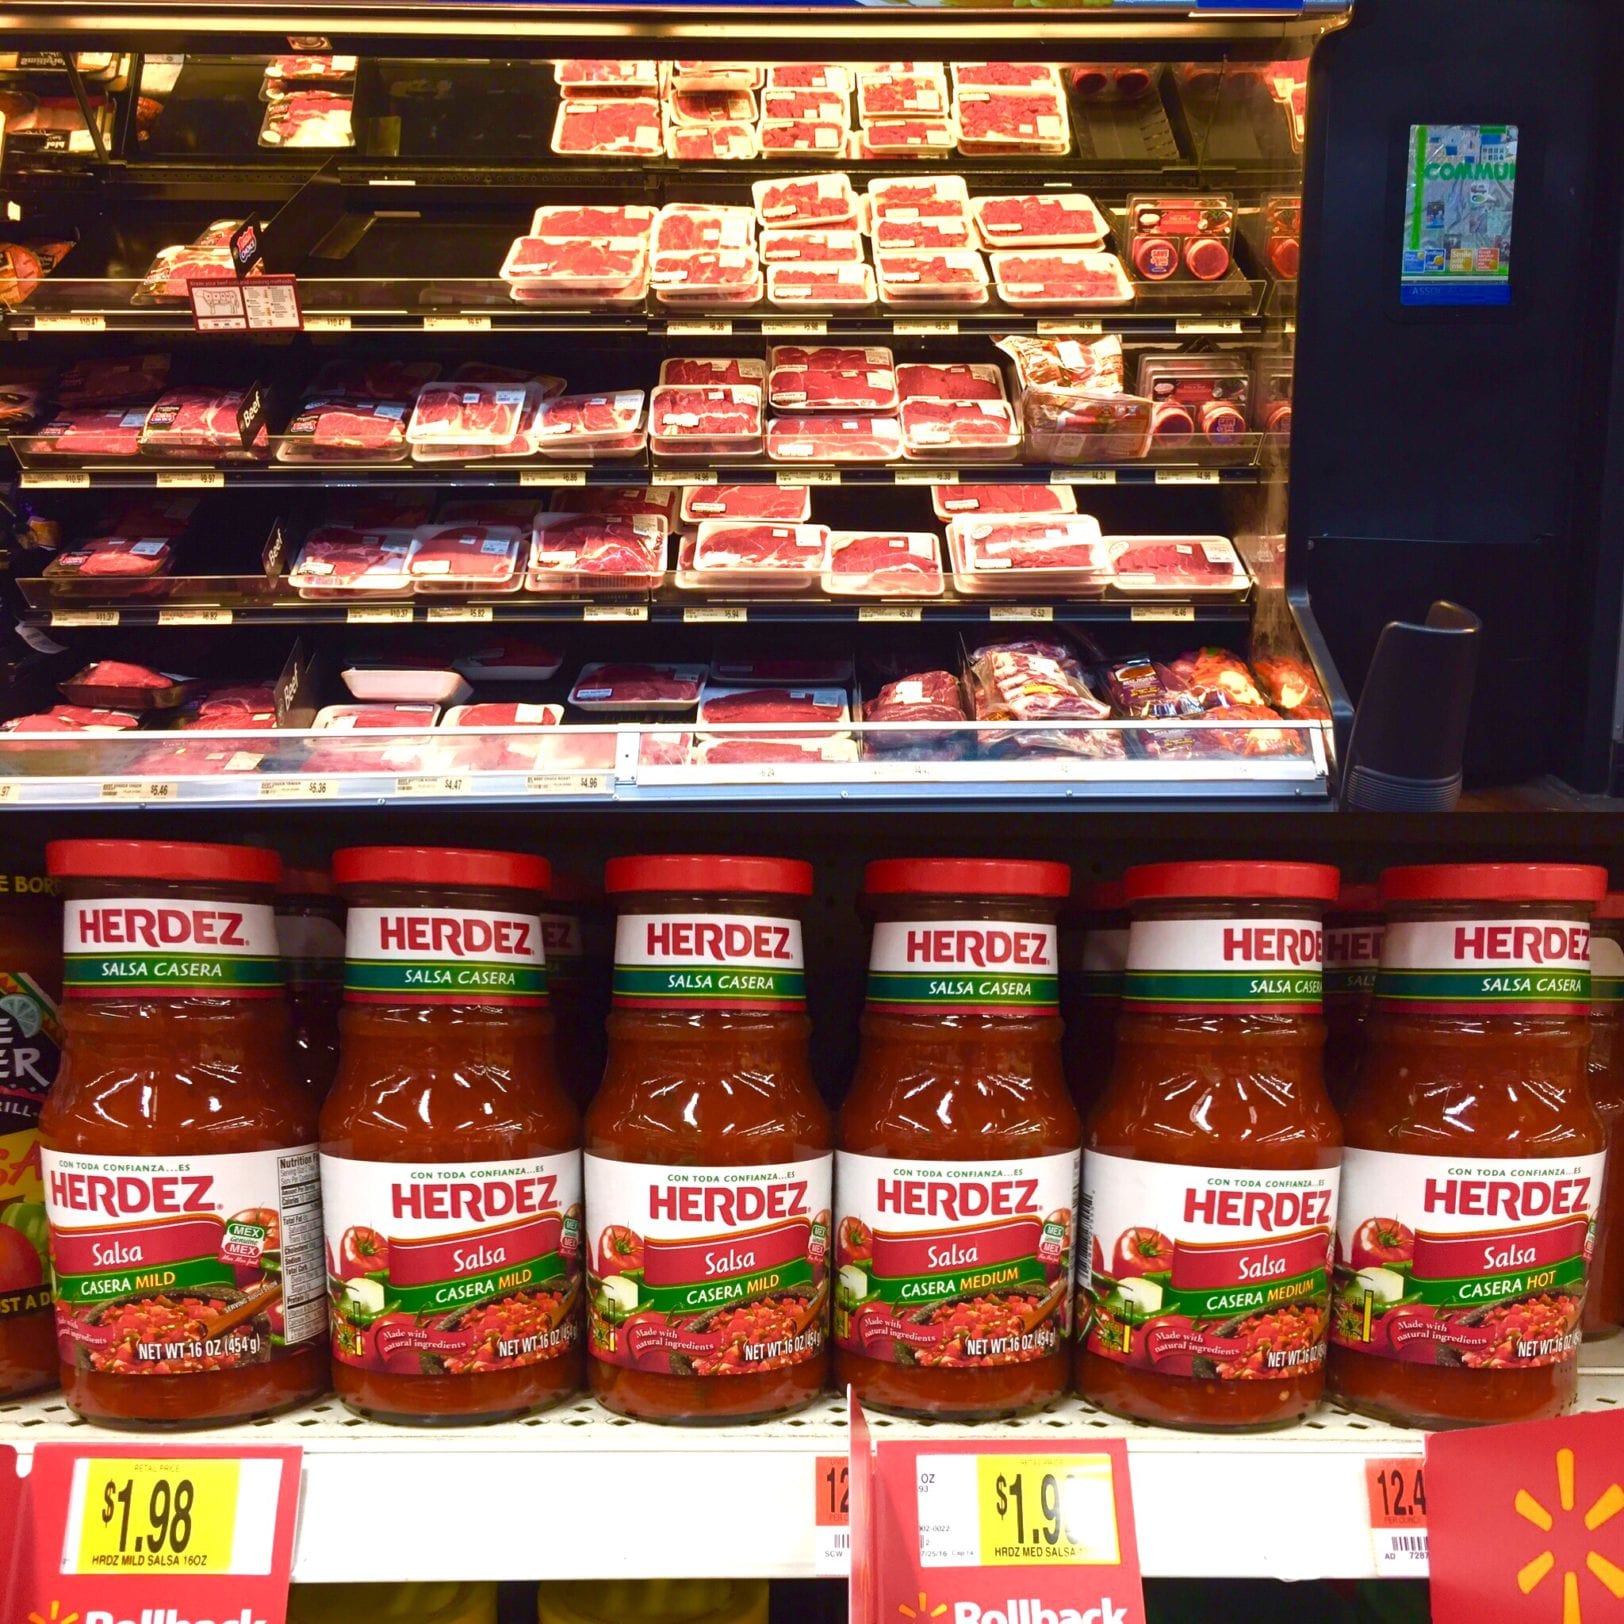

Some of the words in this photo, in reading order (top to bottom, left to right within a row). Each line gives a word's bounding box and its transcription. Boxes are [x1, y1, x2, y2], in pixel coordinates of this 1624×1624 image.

[244, 390, 260, 428] Beef
[150, 784, 168, 796] $5.46
[445, 779, 462, 790] $4.47
[580, 777, 598, 788] $4.96
[79, 909, 246, 947] HERDEZ
[380, 917, 531, 956] HERDEZ
[647, 923, 791, 961] HERDEZ
[907, 930, 1048, 967] HERDEZ
[102, 963, 147, 977] SALSA
[154, 963, 222, 977] CASERA
[405, 970, 451, 984] SALSA
[458, 971, 515, 986] CASERA
[667, 975, 713, 988] SALSA
[718, 975, 774, 989] CASERA
[928, 981, 974, 995] SALSA
[979, 982, 1031, 995] CASERA
[1250, 979, 1291, 993] SALSA
[1481, 978, 1531, 992] SALSA
[1536, 978, 1582, 992] CASERA
[59, 1160, 74, 1168] CON
[77, 1161, 99, 1170] TODA
[103, 1163, 191, 1172] CONFIANZA...ES
[280, 1156, 312, 1169] Nutrition
[410, 1171, 433, 1180] CON
[437, 1170, 466, 1179] TODA
[470, 1165, 544, 1178] CONFIANZA...ES
[667, 1174, 689, 1182] CON
[692, 1174, 720, 1183] TODA
[724, 1171, 795, 1182] CONFIANZA...ES
[893, 1168, 913, 1176] CON
[917, 1169, 942, 1178] TODA
[947, 1168, 1023, 1178] CONFIANZA...ES
[1447, 1168, 1472, 1176] CON
[1477, 1168, 1506, 1177] TODA
[1207, 1178, 1231, 1186] CON
[1234, 1179, 1262, 1187] TODA
[50, 1170, 216, 1217] HERDEZ
[391, 1175, 558, 1222] HERDEZ
[877, 1178, 1039, 1221] HERDEZ
[1423, 1177, 1591, 1221] HERDEZ
[649, 1181, 808, 1226] HERDEZ
[1184, 1188, 1332, 1232] HERDEZ
[234, 1226, 259, 1238] MEX
[1047, 1225, 1062, 1236] MEX
[93, 1243, 143, 1266] Salsa
[229, 1243, 256, 1256] MEX
[928, 1243, 978, 1268] Salsa
[1043, 1243, 1059, 1254] MEX
[453, 1246, 506, 1272] Salsa
[705, 1249, 756, 1275] Salsa
[1483, 1244, 1537, 1270] Salsa
[1238, 1255, 1287, 1280] Salsa
[81, 1278, 132, 1295] CASERA
[136, 1271, 176, 1290] MILD
[436, 1281, 495, 1304] CASERA
[498, 1270, 533, 1289] MILD
[686, 1284, 743, 1305] CASERA
[747, 1274, 780, 1294] MILD
[901, 1279, 956, 1298] CASERA
[959, 1267, 1019, 1291] MEDIUM
[1459, 1278, 1522, 1299] CASERA
[1526, 1270, 1556, 1290] HOT
[1206, 1291, 1264, 1311] CASERA
[1267, 1279, 1314, 1302] MEDIUM
[864, 1317, 884, 1327] Made
[885, 1318, 902, 1329] with
[1398, 1321, 1424, 1331] Made
[1426, 1322, 1448, 1332] with
[383, 1329, 405, 1340] Made
[407, 1329, 428, 1340] with
[635, 1328, 658, 1339] Made
[659, 1328, 678, 1339] with
[865, 1326, 889, 1338] natural
[890, 1327, 936, 1342] ingredients
[1156, 1331, 1180, 1342] Made
[1183, 1333, 1204, 1344] with
[1397, 1330, 1430, 1342] natural
[1431, 1331, 1487, 1345] ingredients
[139, 1343, 161, 1360] NET
[165, 1342, 184, 1359] WT
[189, 1341, 202, 1357] 16
[206, 1339, 221, 1356] OZ
[225, 1337, 248, 1354] (454
[384, 1340, 412, 1352] natural
[413, 1339, 466, 1351] ingredients
[499, 1339, 519, 1357] NET
[522, 1336, 537, 1352] WT
[540, 1333, 548, 1348] 16
[550, 1329, 560, 1346] OZ
[636, 1338, 663, 1350] natural
[664, 1337, 714, 1351] ingredients
[745, 1344, 765, 1361] NET
[767, 1341, 782, 1358] WT
[784, 1338, 793, 1354] 16
[794, 1334, 804, 1352] OZ
[967, 1338, 988, 1356] NET
[990, 1336, 1008, 1354] WT
[1009, 1335, 1020, 1352] 16
[1021, 1333, 1033, 1350] OZ
[1155, 1341, 1186, 1353] natural
[1188, 1342, 1240, 1356] ingredients
[1518, 1341, 1538, 1357] NET
[1540, 1338, 1554, 1355] WT
[1555, 1337, 1563, 1352] 16
[1564, 1333, 1572, 1350] OZ
[1268, 1351, 1286, 1368] NET
[1288, 1349, 1302, 1366] WT
[920, 1472, 935, 1484] OZ
[1378, 1469, 1427, 1516] 12.4
[102, 1478, 194, 1554] $1.98
[996, 1472, 1078, 1545] $1.9
[995, 1547, 1020, 1557] HRDZ
[1022, 1547, 1043, 1557] MED
[1045, 1547, 1076, 1557] SALSA
[92, 1555, 119, 1566] HRDZ
[121, 1555, 145, 1566] MILD
[147, 1555, 180, 1566] SALSA
[183, 1555, 207, 1566] 16OZ
